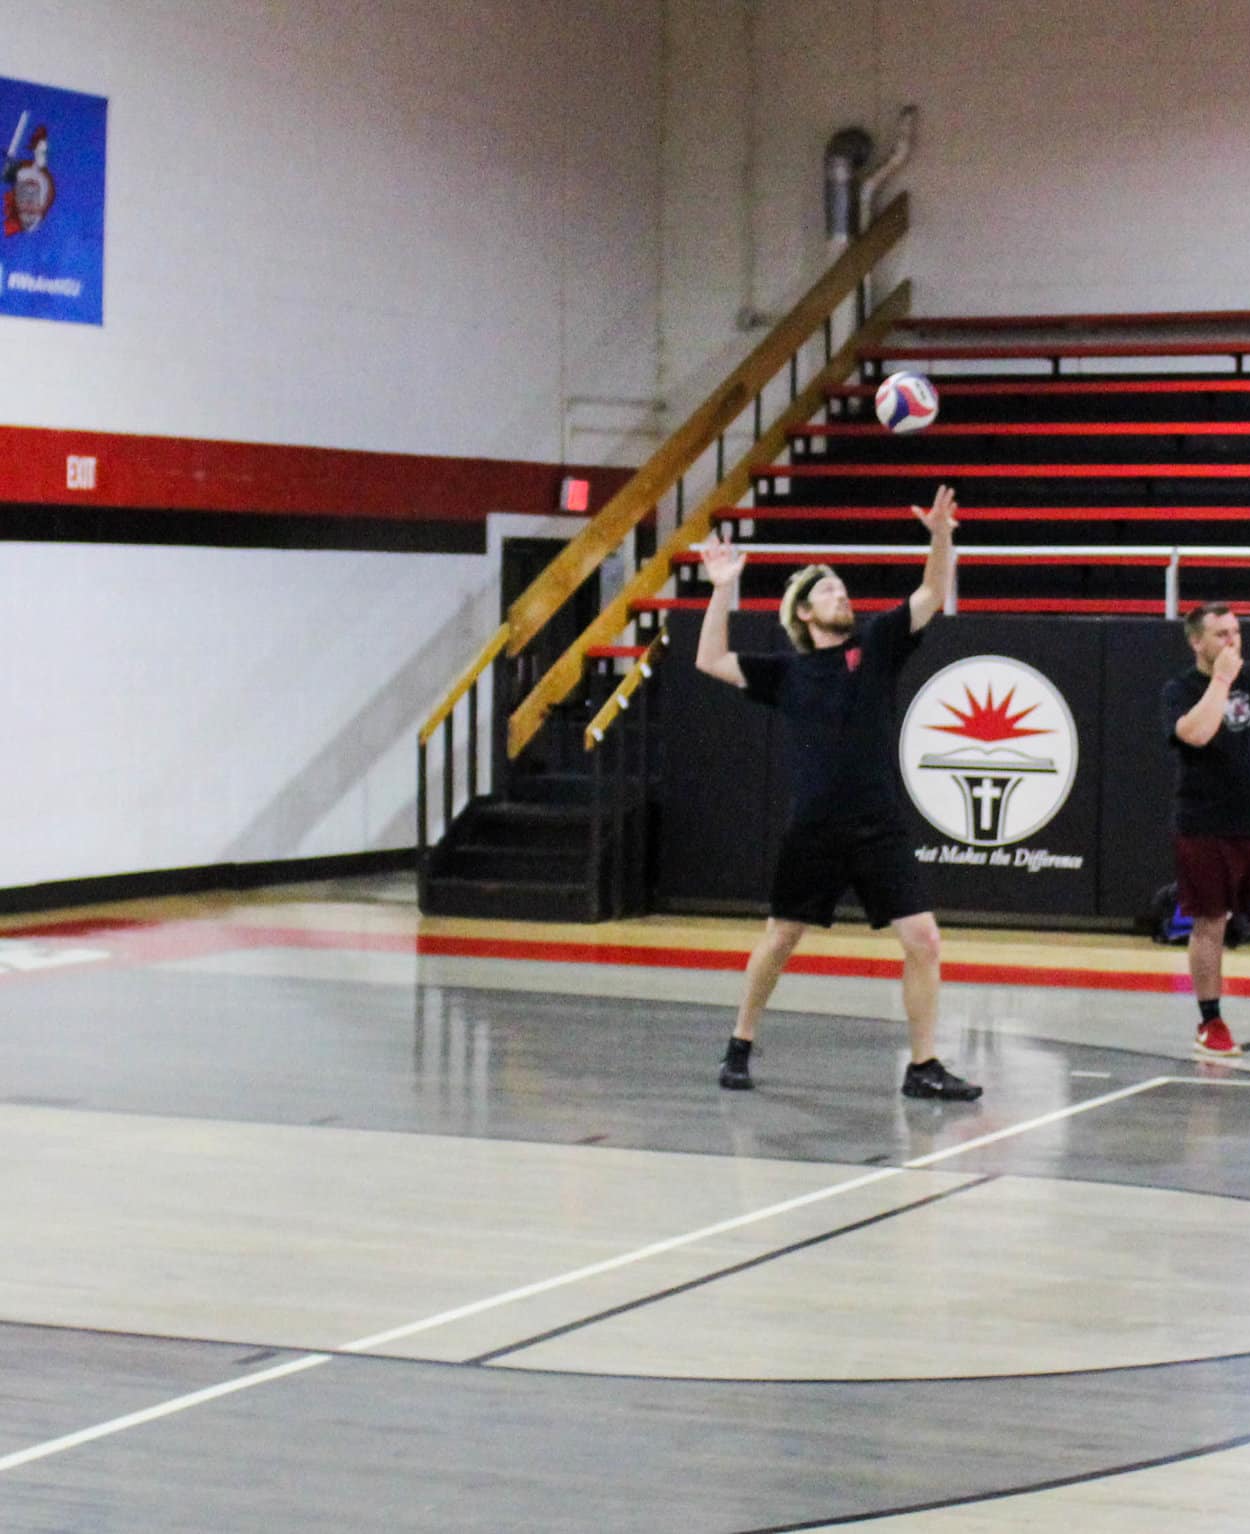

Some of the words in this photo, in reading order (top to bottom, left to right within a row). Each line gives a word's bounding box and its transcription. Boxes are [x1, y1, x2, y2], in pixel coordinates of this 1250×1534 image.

[938, 845, 987, 865] Makes
[989, 847, 1011, 866] the
[1013, 848, 1083, 872] Difference
